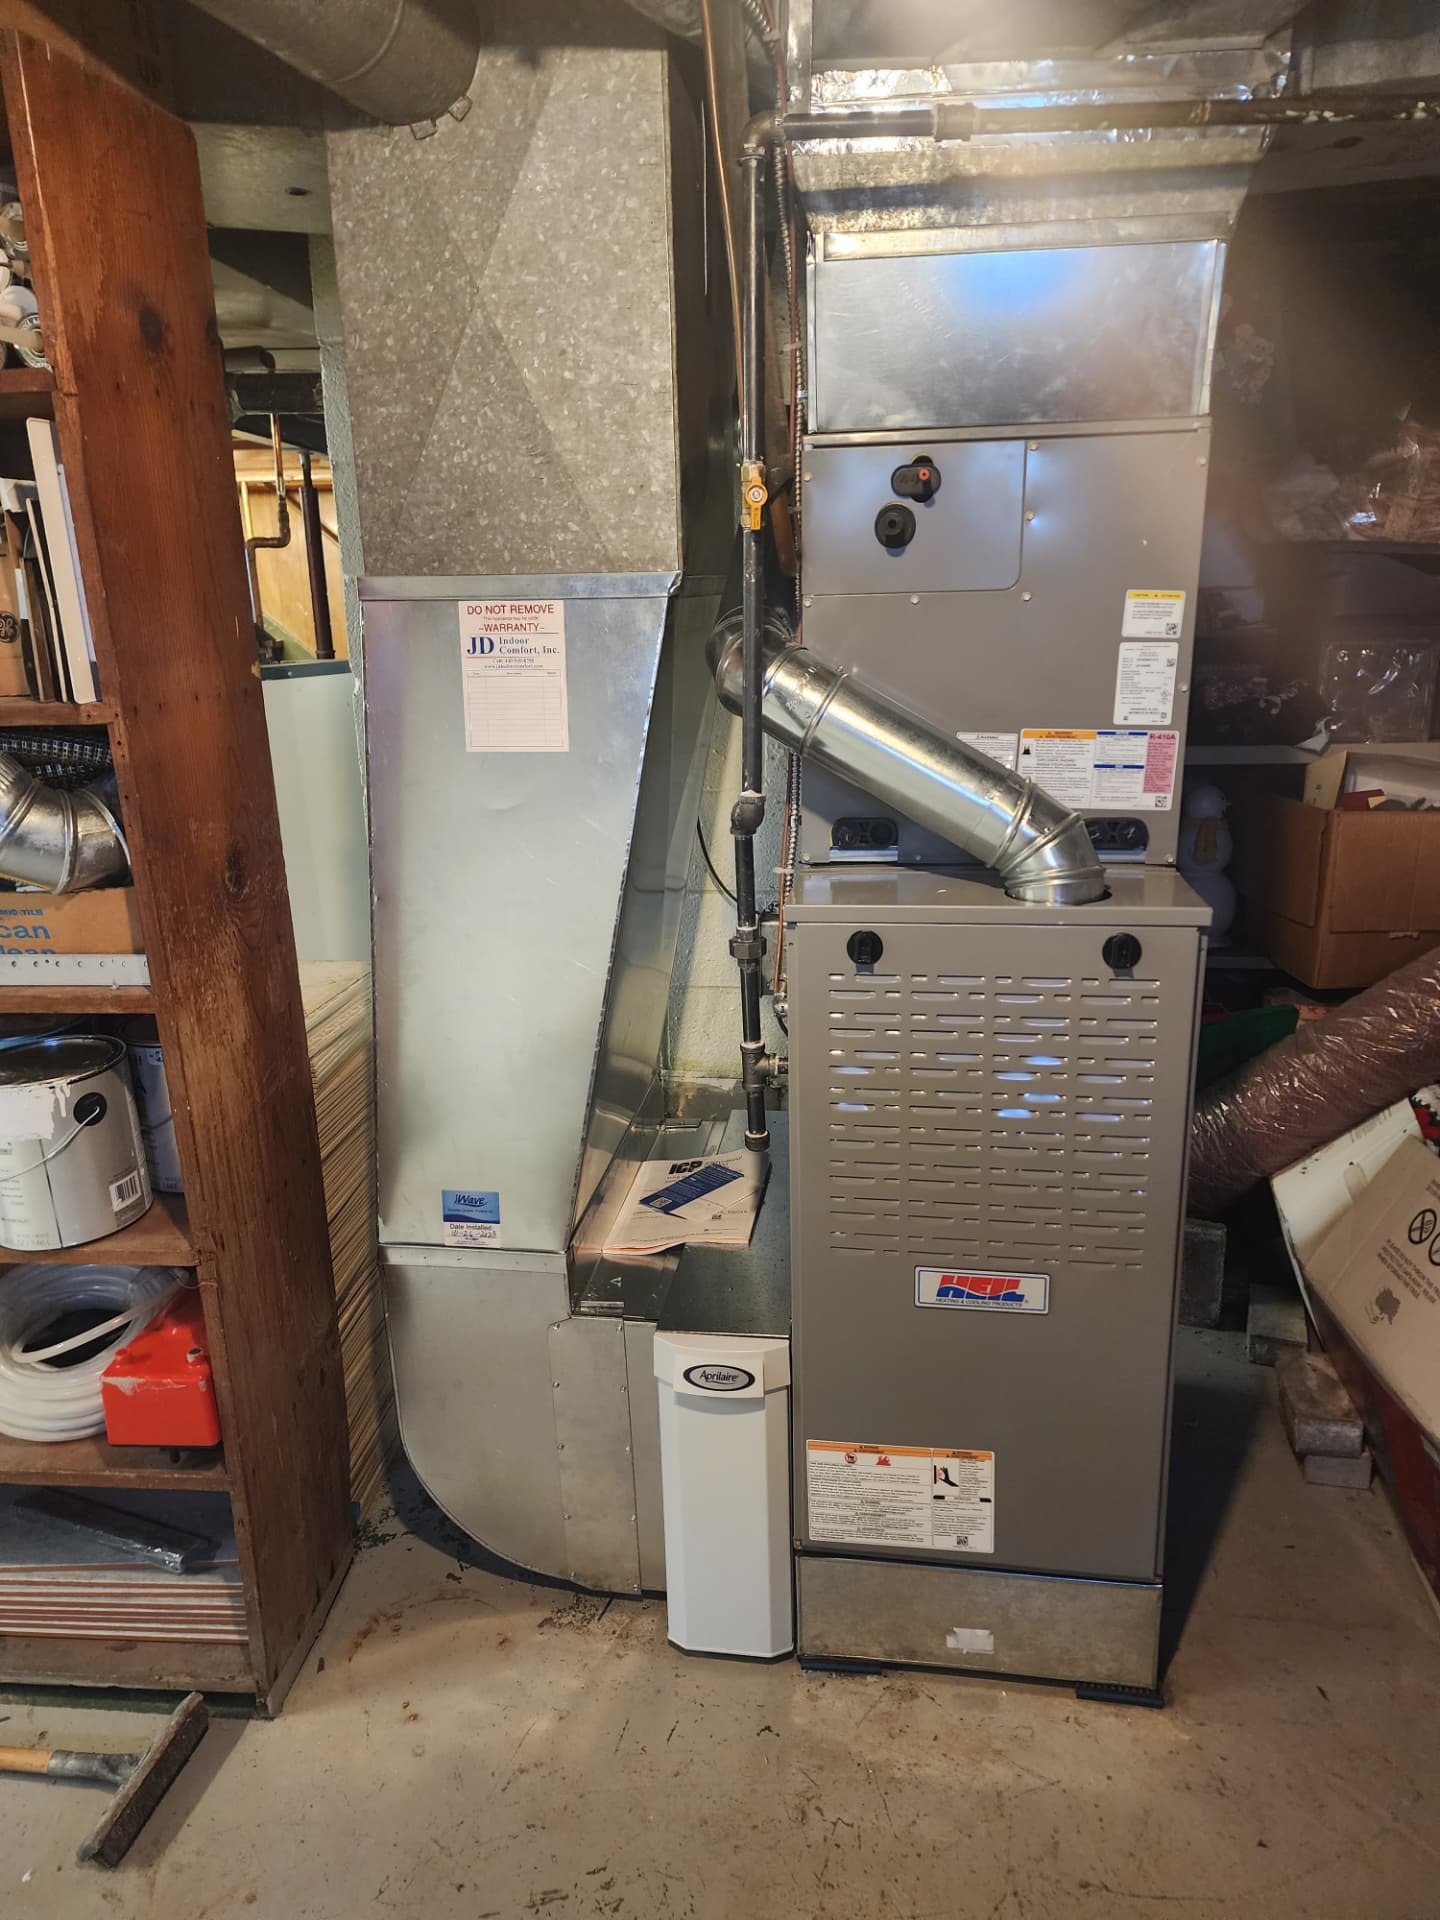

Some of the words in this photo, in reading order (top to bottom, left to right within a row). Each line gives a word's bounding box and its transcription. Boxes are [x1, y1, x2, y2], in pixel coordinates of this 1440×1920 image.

[467, 605, 482, 615] DO
[485, 605, 506, 615] NOT
[510, 604, 554, 614] REMOVE
[467, 636, 494, 655] JD
[499, 636, 529, 645] Indoor
[499, 645, 540, 655] Comfort,
[543, 645, 560, 654] Inc.
[669, 1161, 703, 1175] ICP
[936, 1274, 1025, 1303] HEIL
[700, 1370, 738, 1383] Aprilaire
